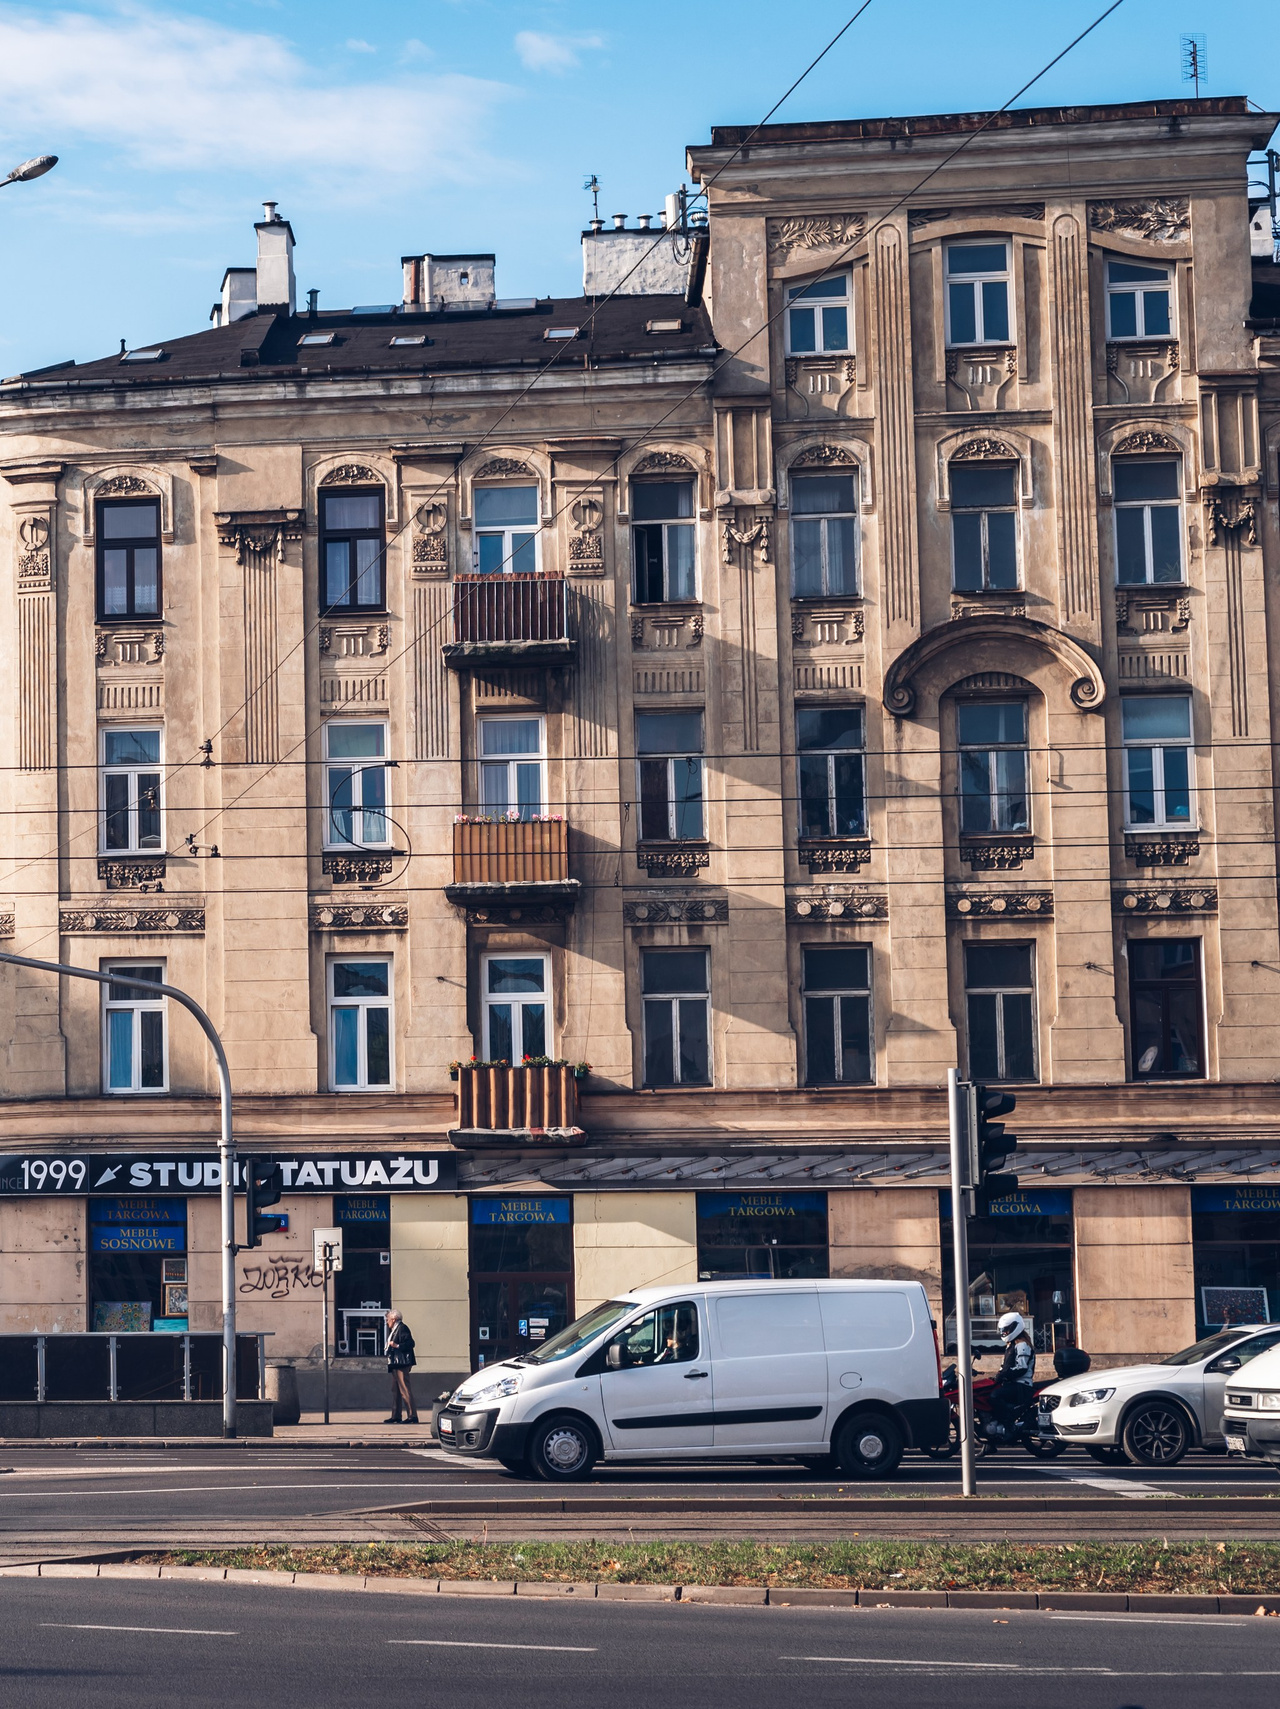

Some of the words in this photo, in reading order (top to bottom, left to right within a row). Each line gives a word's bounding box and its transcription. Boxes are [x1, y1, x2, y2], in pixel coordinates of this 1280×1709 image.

[21, 1159, 87, 1190] 1999
[276, 1157, 439, 1186] TATUAŻU
[989, 1193, 1028, 1203] EBLE
[1235, 1189, 1280, 1199] MEBLE
[118, 1199, 158, 1209] MEBLE
[347, 1199, 378, 1209] MEBLE
[501, 1201, 543, 1212] MEBLE
[740, 1196, 783, 1206] MEBLE
[728, 1206, 797, 1217] TARGOWA
[991, 1203, 1042, 1214] RGOWA
[107, 1209, 170, 1220] TARGOWA
[339, 1209, 387, 1220] TARGOWA
[489, 1212, 556, 1222] TARGOWA
[119, 1228, 159, 1238] MEBLE
[100, 1238, 176, 1249] SOSNOWE
